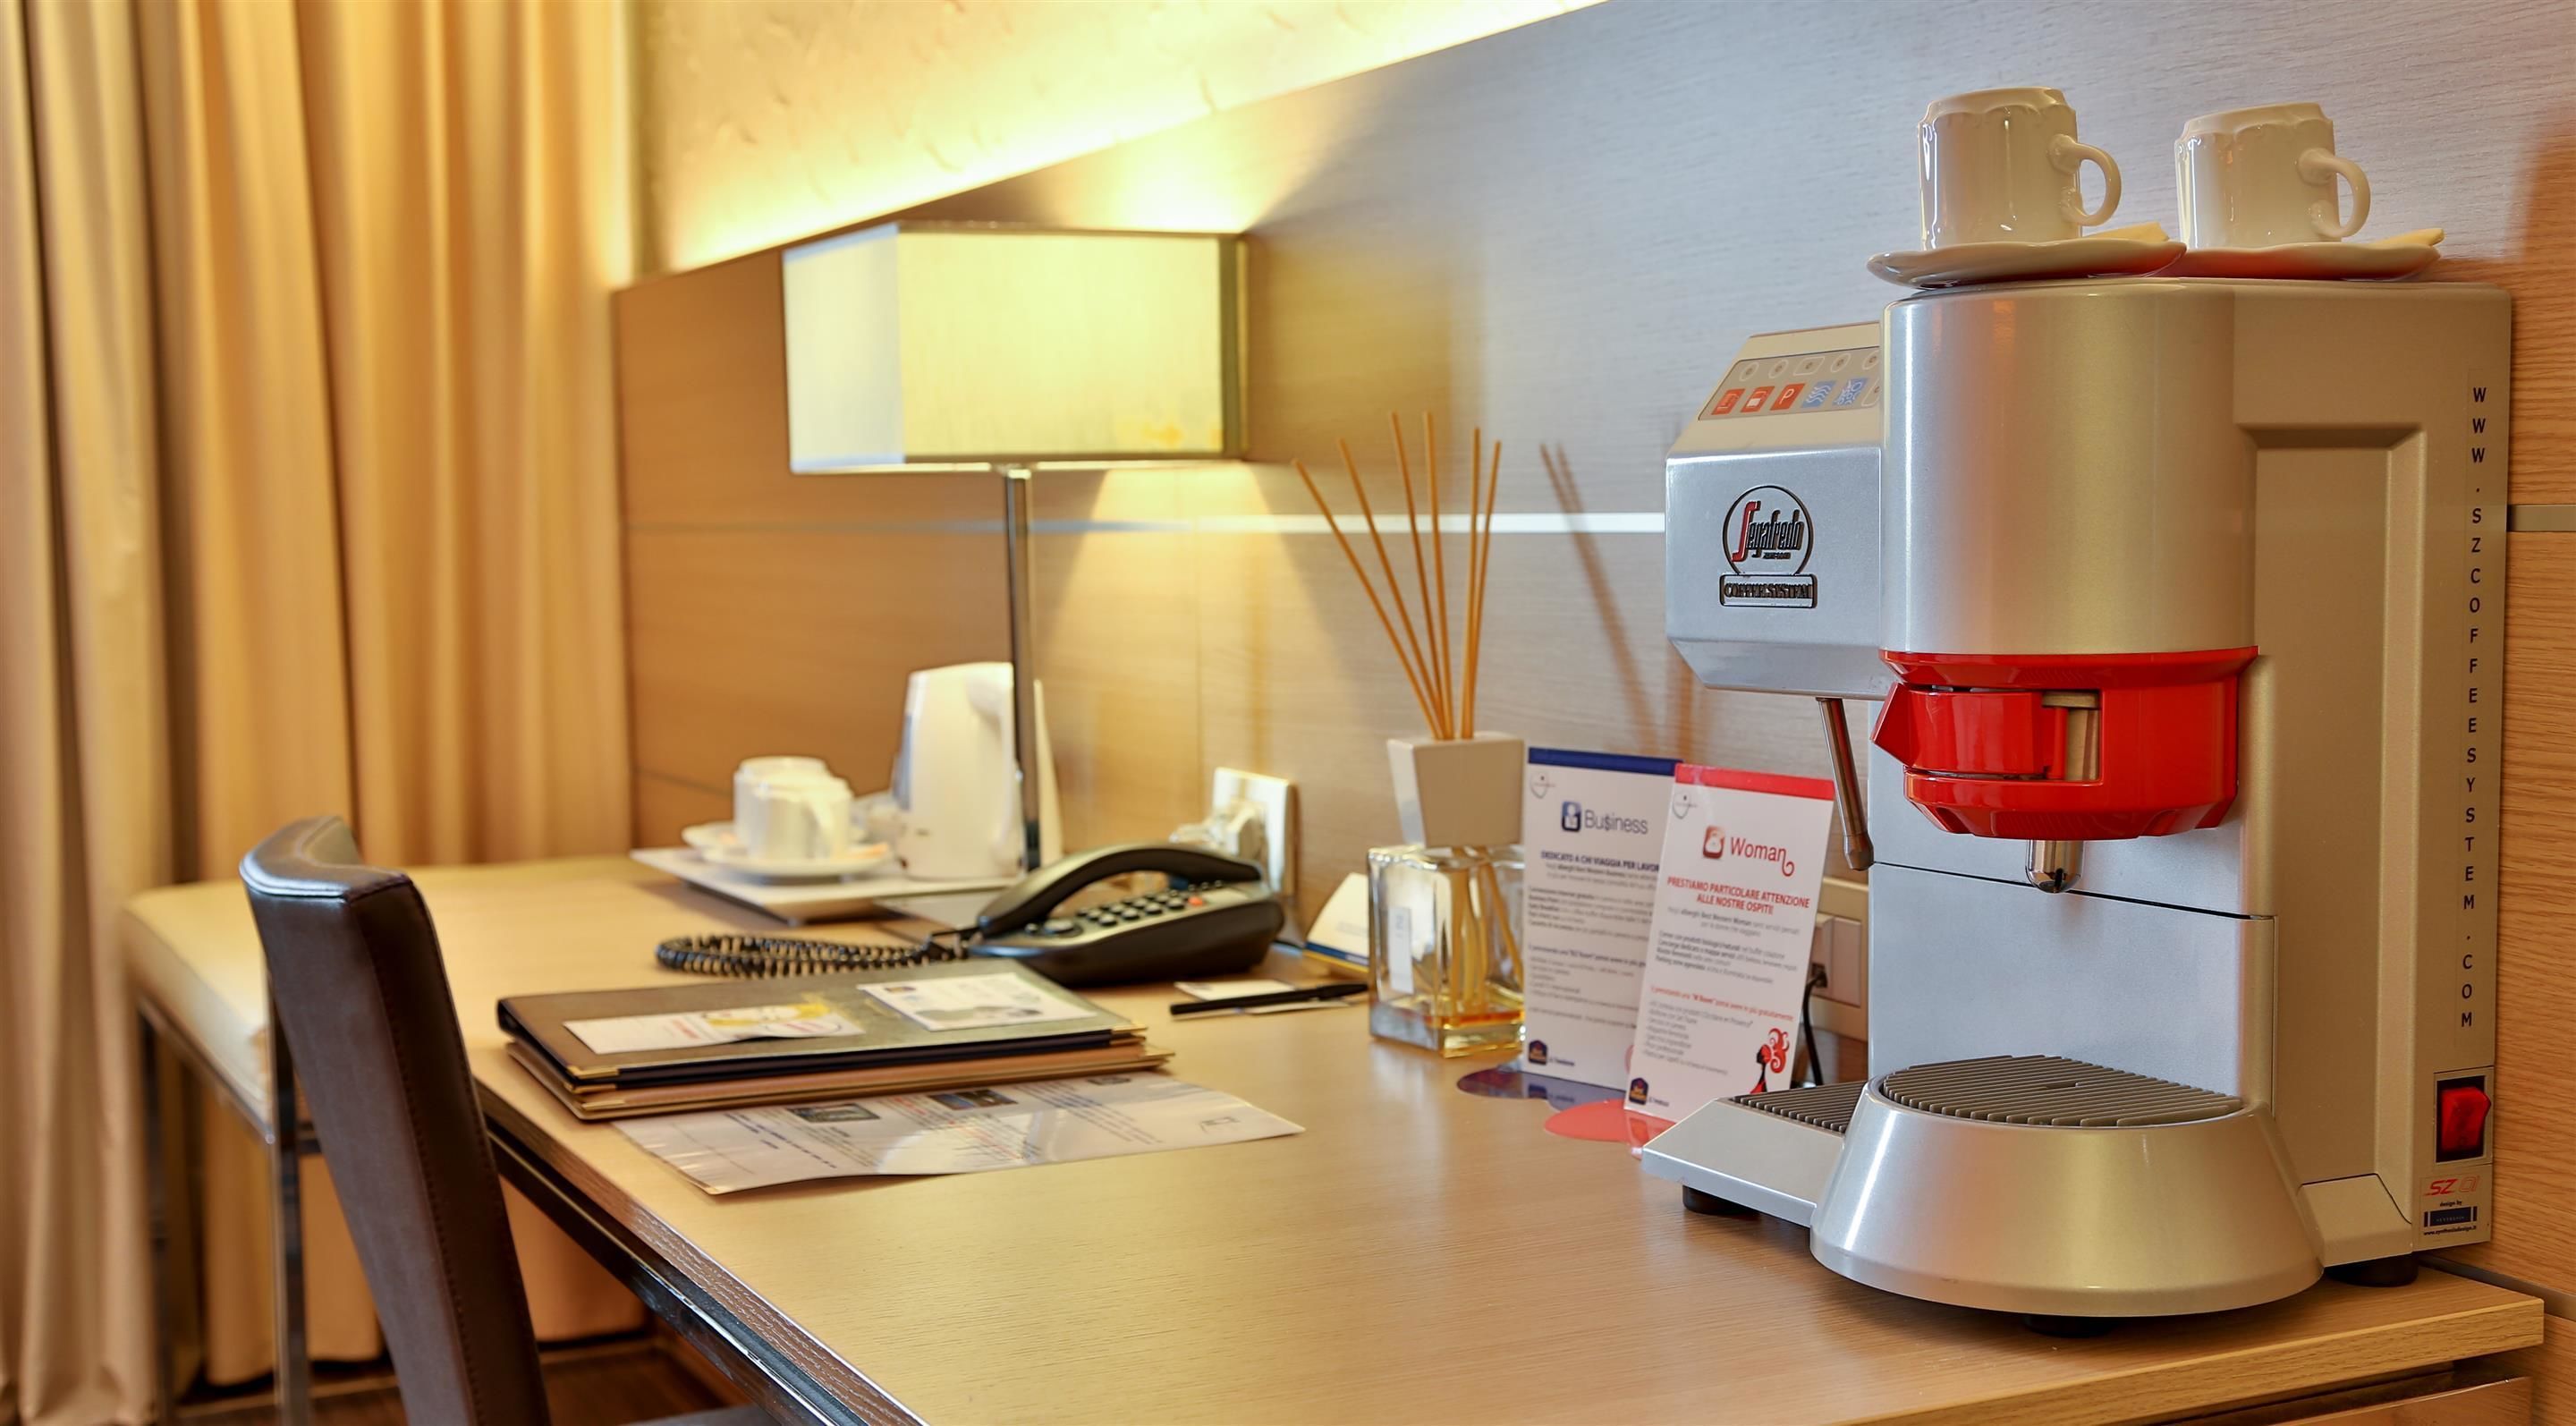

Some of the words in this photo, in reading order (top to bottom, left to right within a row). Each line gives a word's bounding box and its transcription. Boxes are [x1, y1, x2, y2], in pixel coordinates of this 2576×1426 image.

[1732, 500, 1805, 563] Segafredo
[1541, 851, 1573, 862] DEDICATO
[1594, 857, 1622, 868] VIAGGIA
[1623, 860, 1636, 870] PER
[1637, 862, 1660, 872] LAVOR
[1730, 836, 1795, 878] Woman
[1667, 876, 1708, 891] PRESTIAMO
[1709, 884, 1760, 900] PARTICOLARE
[1761, 893, 1810, 909] ATTENZIONE
[1697, 894, 1716, 904] ALLE
[1716, 896, 1745, 910] NOSTRE
